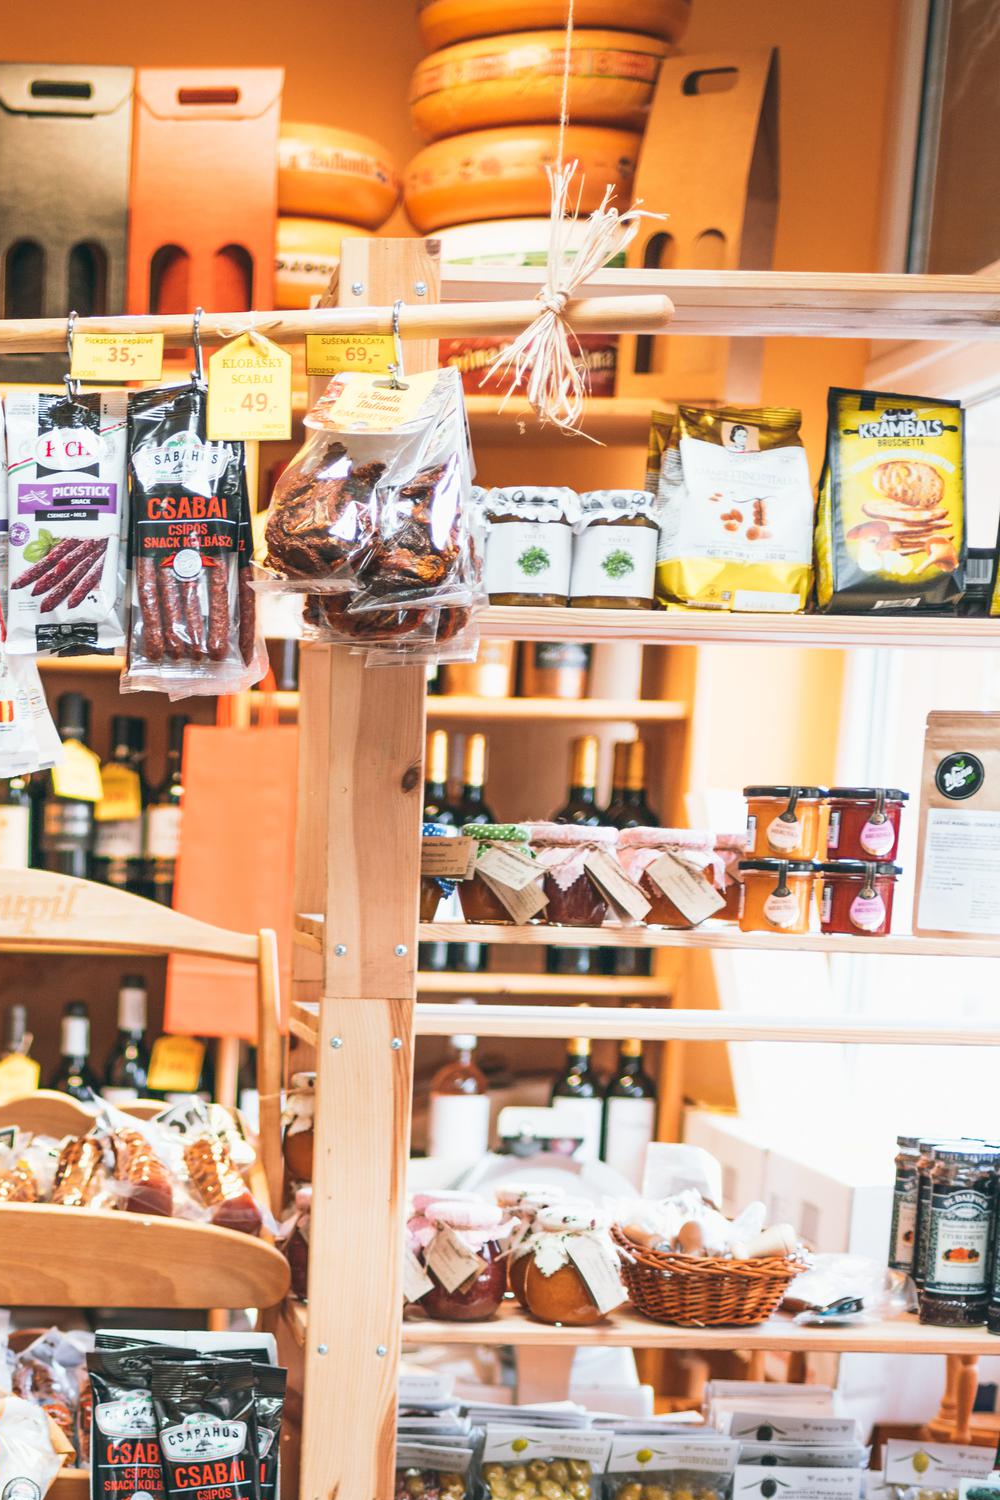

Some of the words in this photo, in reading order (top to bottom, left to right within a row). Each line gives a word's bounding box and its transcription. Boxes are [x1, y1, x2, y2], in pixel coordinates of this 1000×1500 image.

[85, 336, 117, 345] Pickstick
[321, 336, 350, 345] SUŠENÁ
[351, 337, 385, 345] RAJČATA
[107, 347, 144, 367] 35,-
[345, 347, 380, 364] 69,-
[240, 393, 278, 414] 49,-
[858, 419, 943, 438] KRAMBALS
[877, 439, 925, 447] BRUSCHETTA
[53, 487, 110, 497] PICKSTICK
[147, 496, 228, 520] CSABAI
[144, 537, 180, 549] SNACK
[106, 1443, 161, 1464] CSAB
[175, 1460, 245, 1488] CSABAI
[104, 1480, 135, 1491] SNACK
[137, 1479, 164, 1490] KOLB
